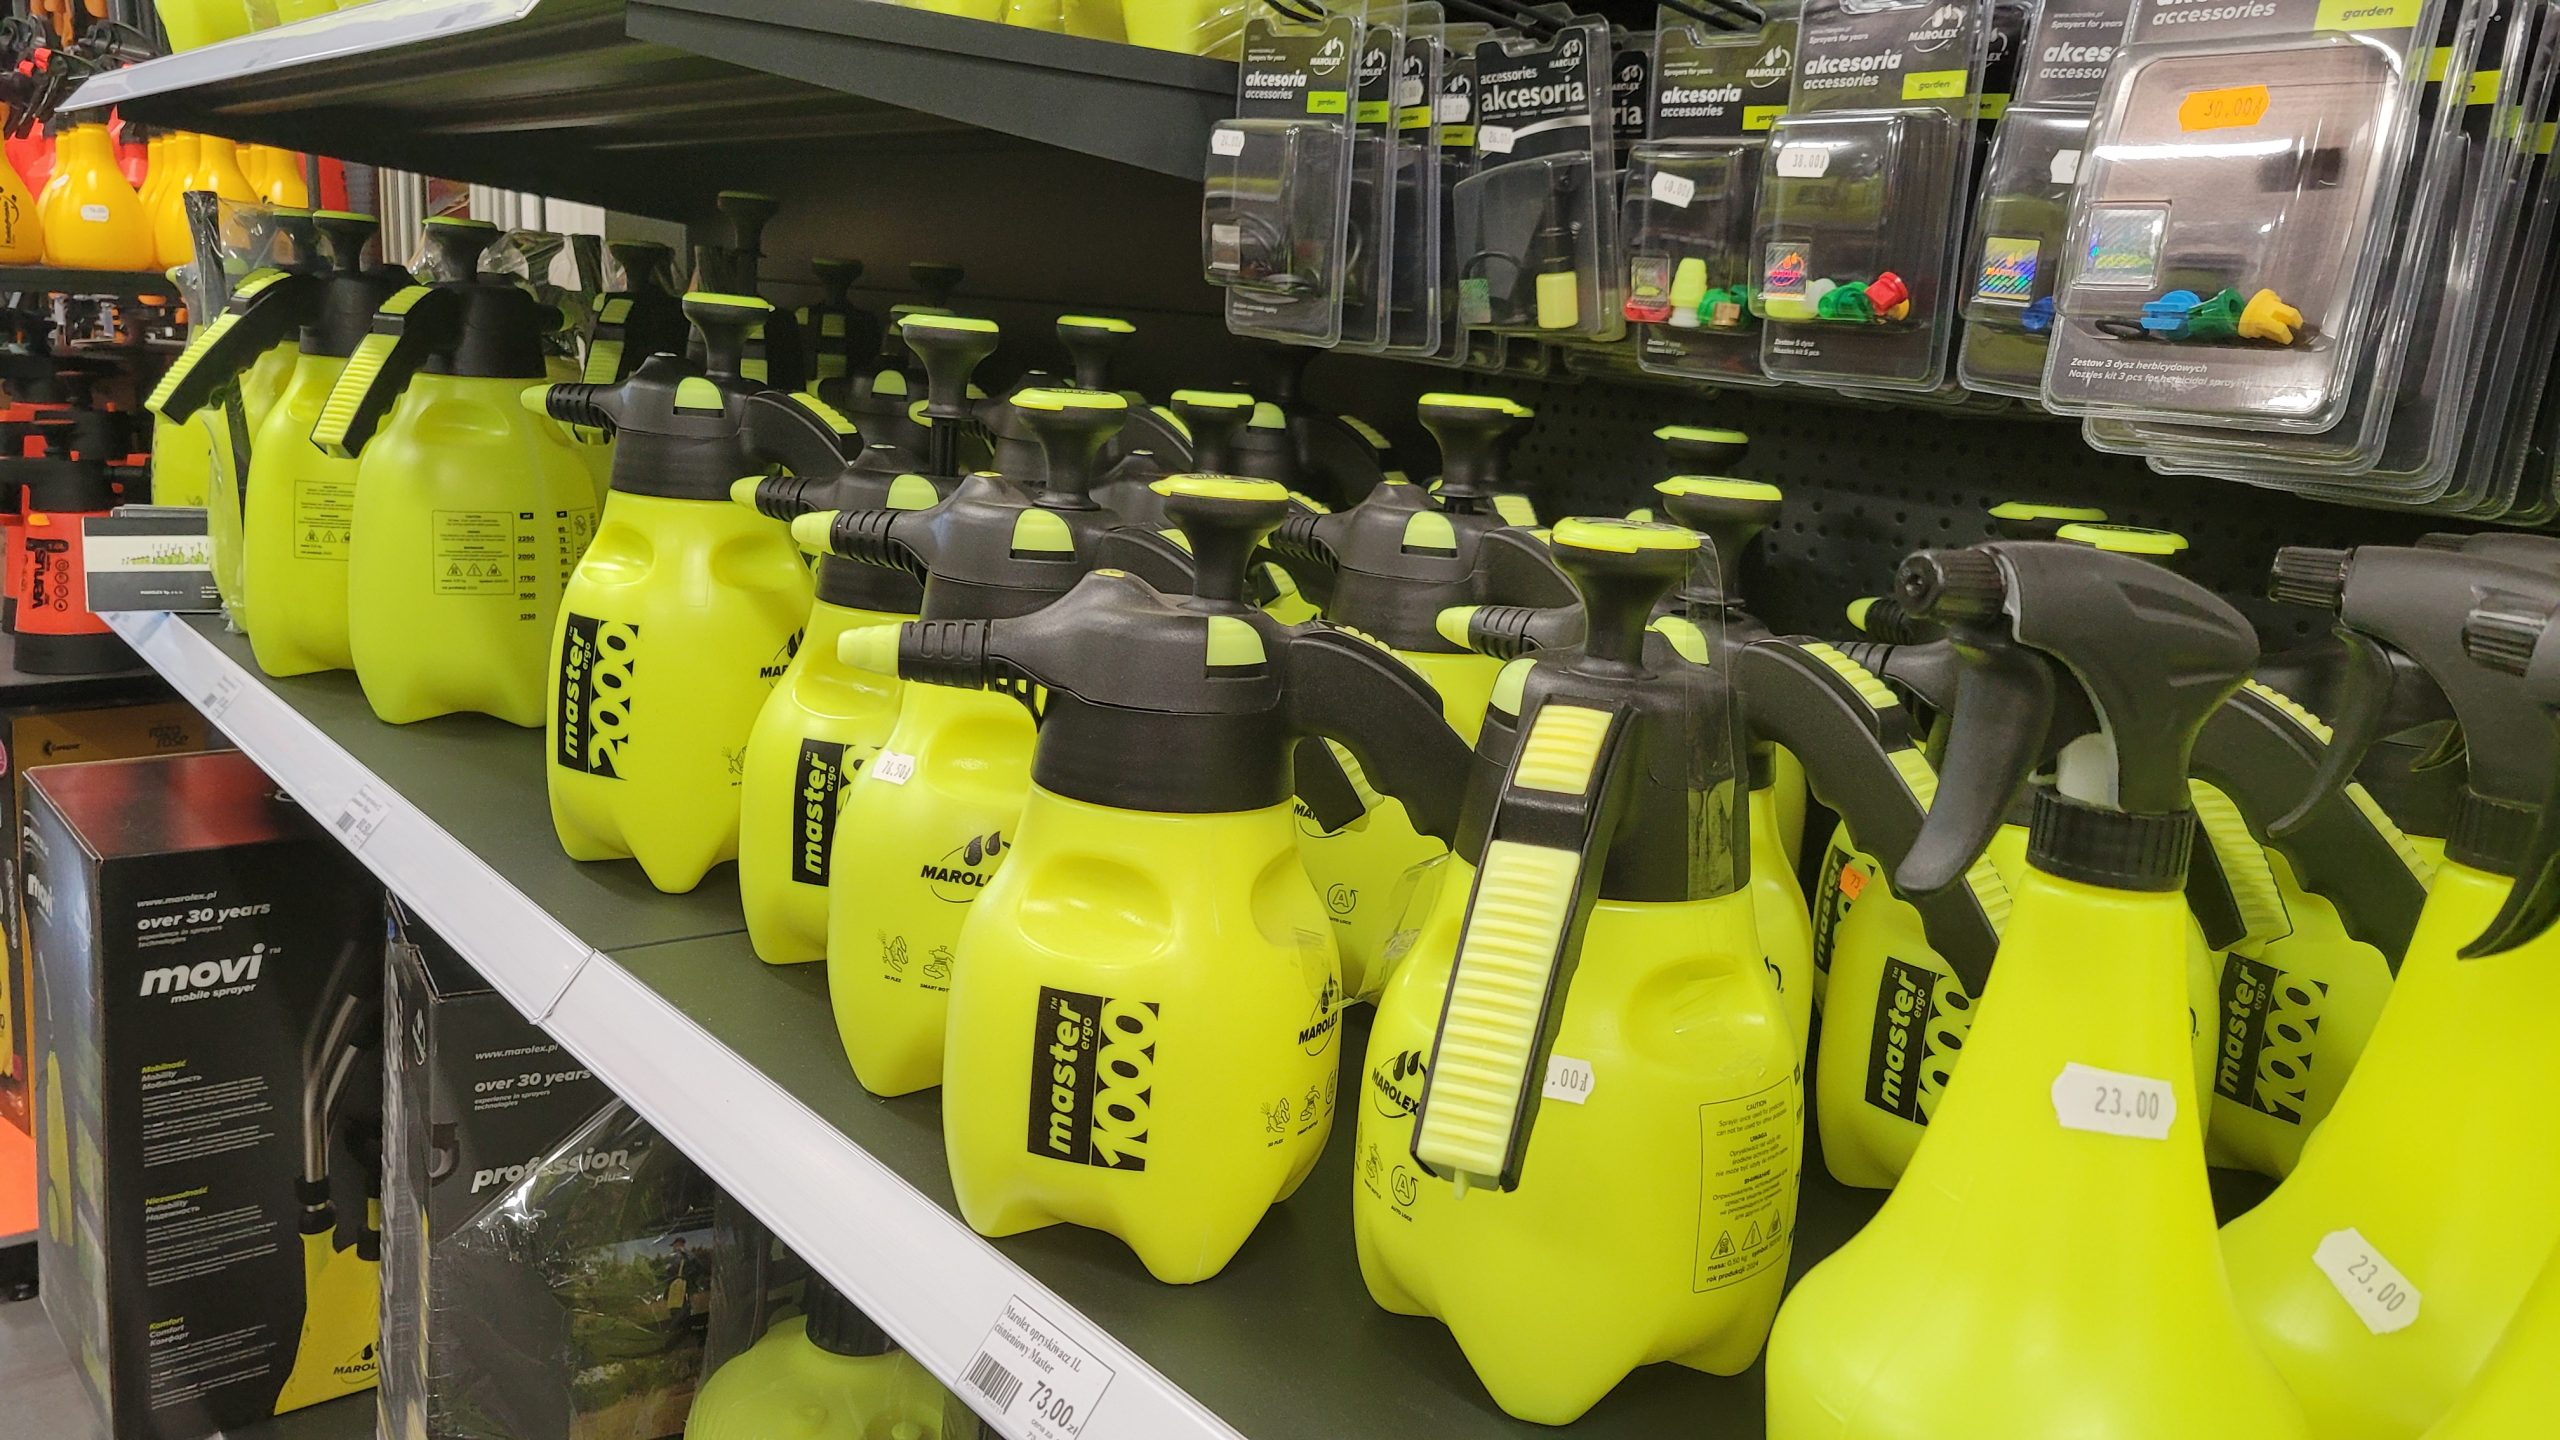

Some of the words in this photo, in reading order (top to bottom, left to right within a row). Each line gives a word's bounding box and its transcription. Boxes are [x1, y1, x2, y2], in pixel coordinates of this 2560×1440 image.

[2152, 1, 2276, 26] accessories
[2342, 5, 2394, 21] garden
[1908, 28, 1960, 42] MAROLEX
[2051, 20, 2086, 30] Sprayers
[2086, 20, 2099, 28] for
[2099, 20, 2124, 29] years
[1310, 57, 1341, 66] MAROLEX
[1804, 49, 1903, 75] akcesoria
[2043, 41, 2114, 63] akces
[1245, 69, 1307, 88] akcesoria
[1480, 66, 1538, 85] accessories
[1746, 67, 1787, 78] MAROLEX
[1803, 73, 1880, 90] accessories
[1244, 88, 1293, 100] accessories
[1481, 75, 1586, 113] akcesoria
[1660, 83, 1743, 104] akcesoria
[1918, 79, 1951, 91] garden
[1660, 104, 1724, 117] accessories
[2070, 357, 2103, 368] Zestaw
[2104, 359, 2113, 368] 3
[2113, 359, 2135, 371] dysz
[2135, 360, 2208, 374] herbicydowych
[2103, 371, 2117, 381] kit
[2117, 373, 2125, 381] 3
[2125, 374, 2143, 384] pcs
[582, 642, 592, 671] ergo
[564, 626, 585, 759] master
[588, 618, 640, 781] 2000
[826, 765, 836, 792] ergo
[803, 752, 829, 876] master
[137, 890, 218, 908] www.marolex.pl
[137, 913, 184, 931] over
[185, 907, 215, 924] 30
[216, 903, 271, 923] years
[139, 942, 266, 997] movi
[170, 990, 211, 1004] mobile
[212, 983, 256, 999] sprayer
[936, 985, 950, 993] BOT
[2254, 983, 2266, 1011] ergo
[1050, 996, 1059, 1011] TM
[1914, 988, 1926, 1019] ergo
[1081, 1017, 1094, 1050] ergo
[1881, 969, 1917, 1110] master
[2219, 964, 2258, 1095] master
[475, 1043, 559, 1061] www.marolex.pl
[2254, 969, 2328, 1126] 1000
[474, 1076, 515, 1093] over
[516, 1072, 542, 1088] 30
[543, 1068, 592, 1087] years
[1048, 998, 1082, 1155] master
[1089, 996, 1160, 1172] 1000
[512, 1092, 521, 1100] in
[1372, 1067, 1421, 1116] MAROLEX
[1746, 1099, 1767, 1112] CAUTION
[2094, 1085, 2160, 1121] 23.00
[1749, 1131, 1768, 1143] UWAGA
[594, 1171, 625, 1188] plus
[1706, 1274, 1718, 1284] rok
[2347, 1254, 2406, 1312] 23.00
[148, 1316, 184, 1331] Komfort
[148, 1323, 185, 1339] Comfort
[1003, 1304, 1031, 1333] Marolex
[1029, 1326, 1072, 1366] opryskiwacz
[1070, 1356, 1082, 1374] 1L
[333, 1362, 377, 1376] MAROL
[1028, 1347, 1055, 1375] Master
